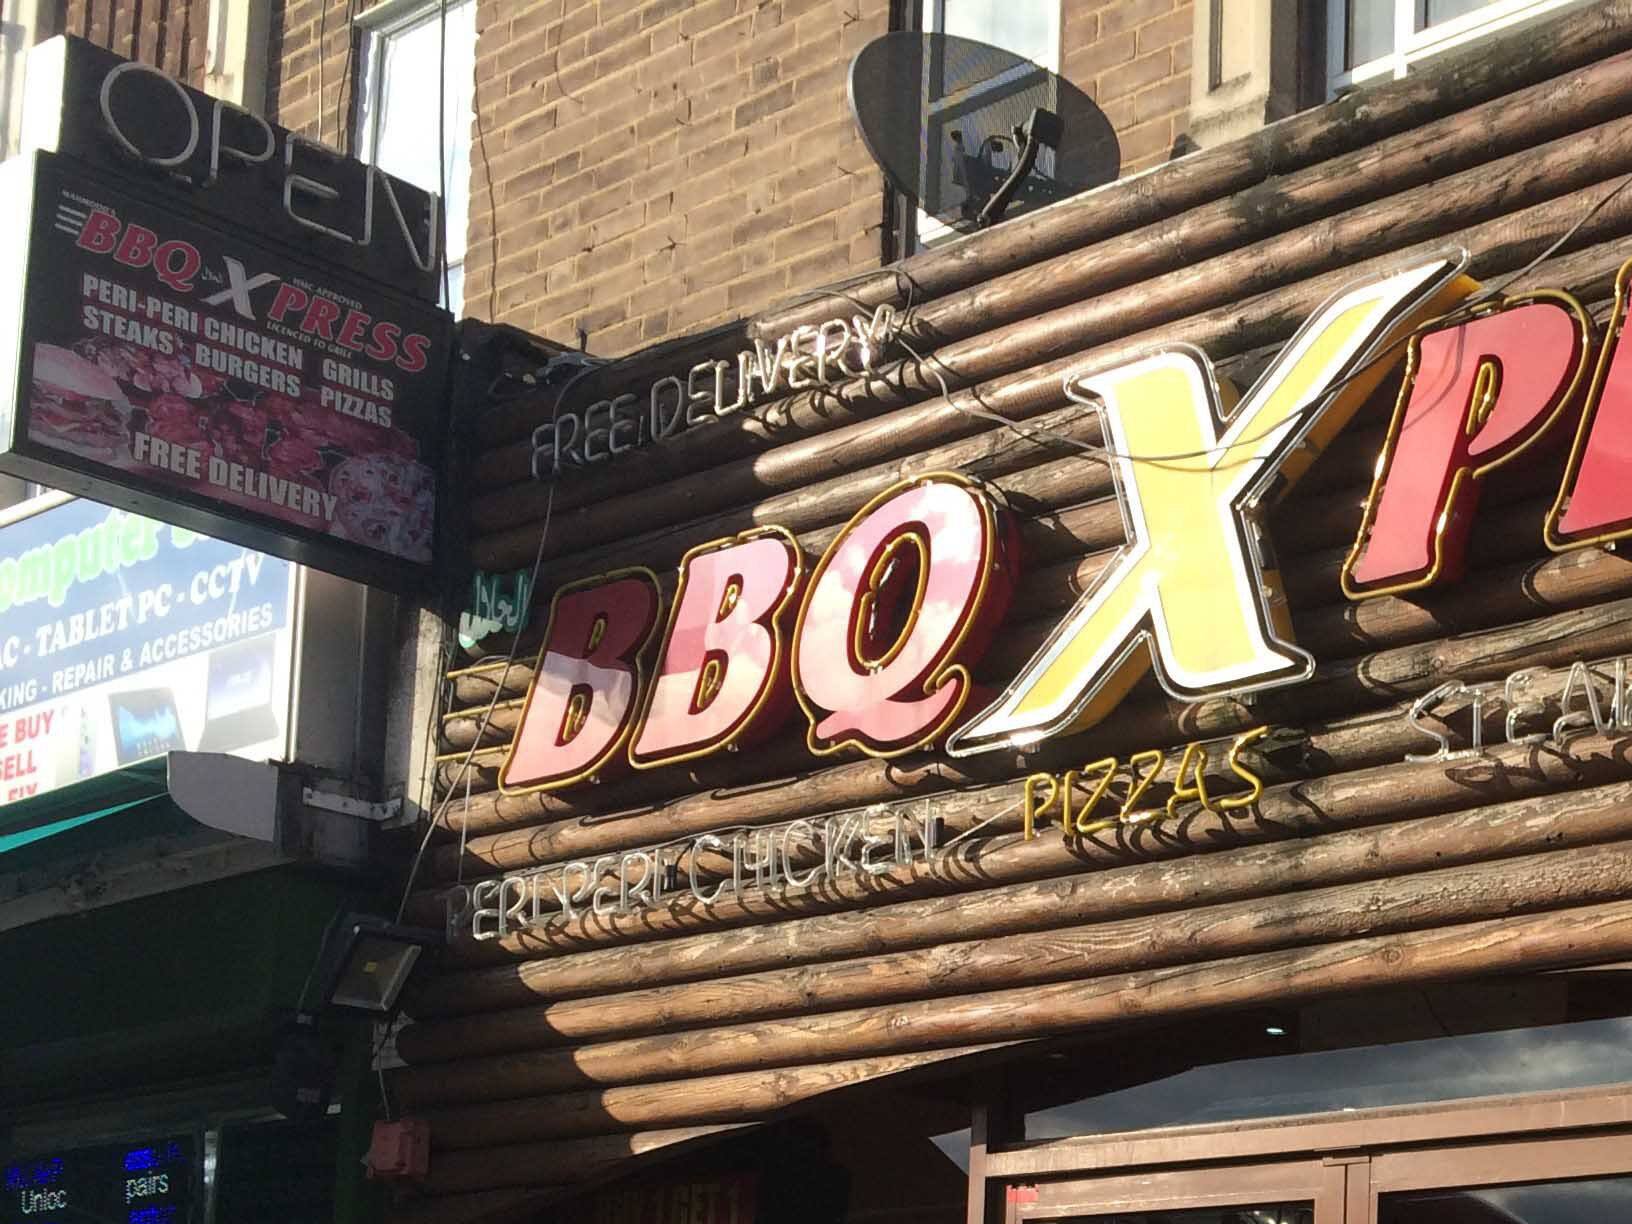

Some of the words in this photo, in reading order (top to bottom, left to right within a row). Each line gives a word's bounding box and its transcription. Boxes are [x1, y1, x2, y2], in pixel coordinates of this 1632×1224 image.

[100, 61, 439, 273] OPEN
[76, 210, 201, 292] BBQ
[83, 272, 198, 334] PERI-PERI
[204, 316, 304, 371] CHICKEN
[322, 358, 394, 401] GRILLS
[83, 309, 174, 356] STEAKS
[195, 342, 300, 397] BURGERS
[320, 384, 393, 428] PIZZAS
[531, 393, 638, 480] FREE
[651, 303, 897, 444] DELIVERY
[134, 431, 200, 479] FREE
[208, 453, 338, 521] DELIVERY
[36, 597, 136, 657] TABLET
[136, 584, 173, 623] PC
[190, 550, 264, 605] CCTV
[52, 653, 115, 695] REPAIR
[121, 648, 133, 672] &
[139, 603, 273, 668] ACCESSORIES
[498, 472, 994, 796] BBQ
[0, 751, 37, 782] ELL
[14, 709, 55, 744] BUY
[1024, 725, 1271, 840] PIZZAS
[689, 799, 945, 905] CHICKEN
